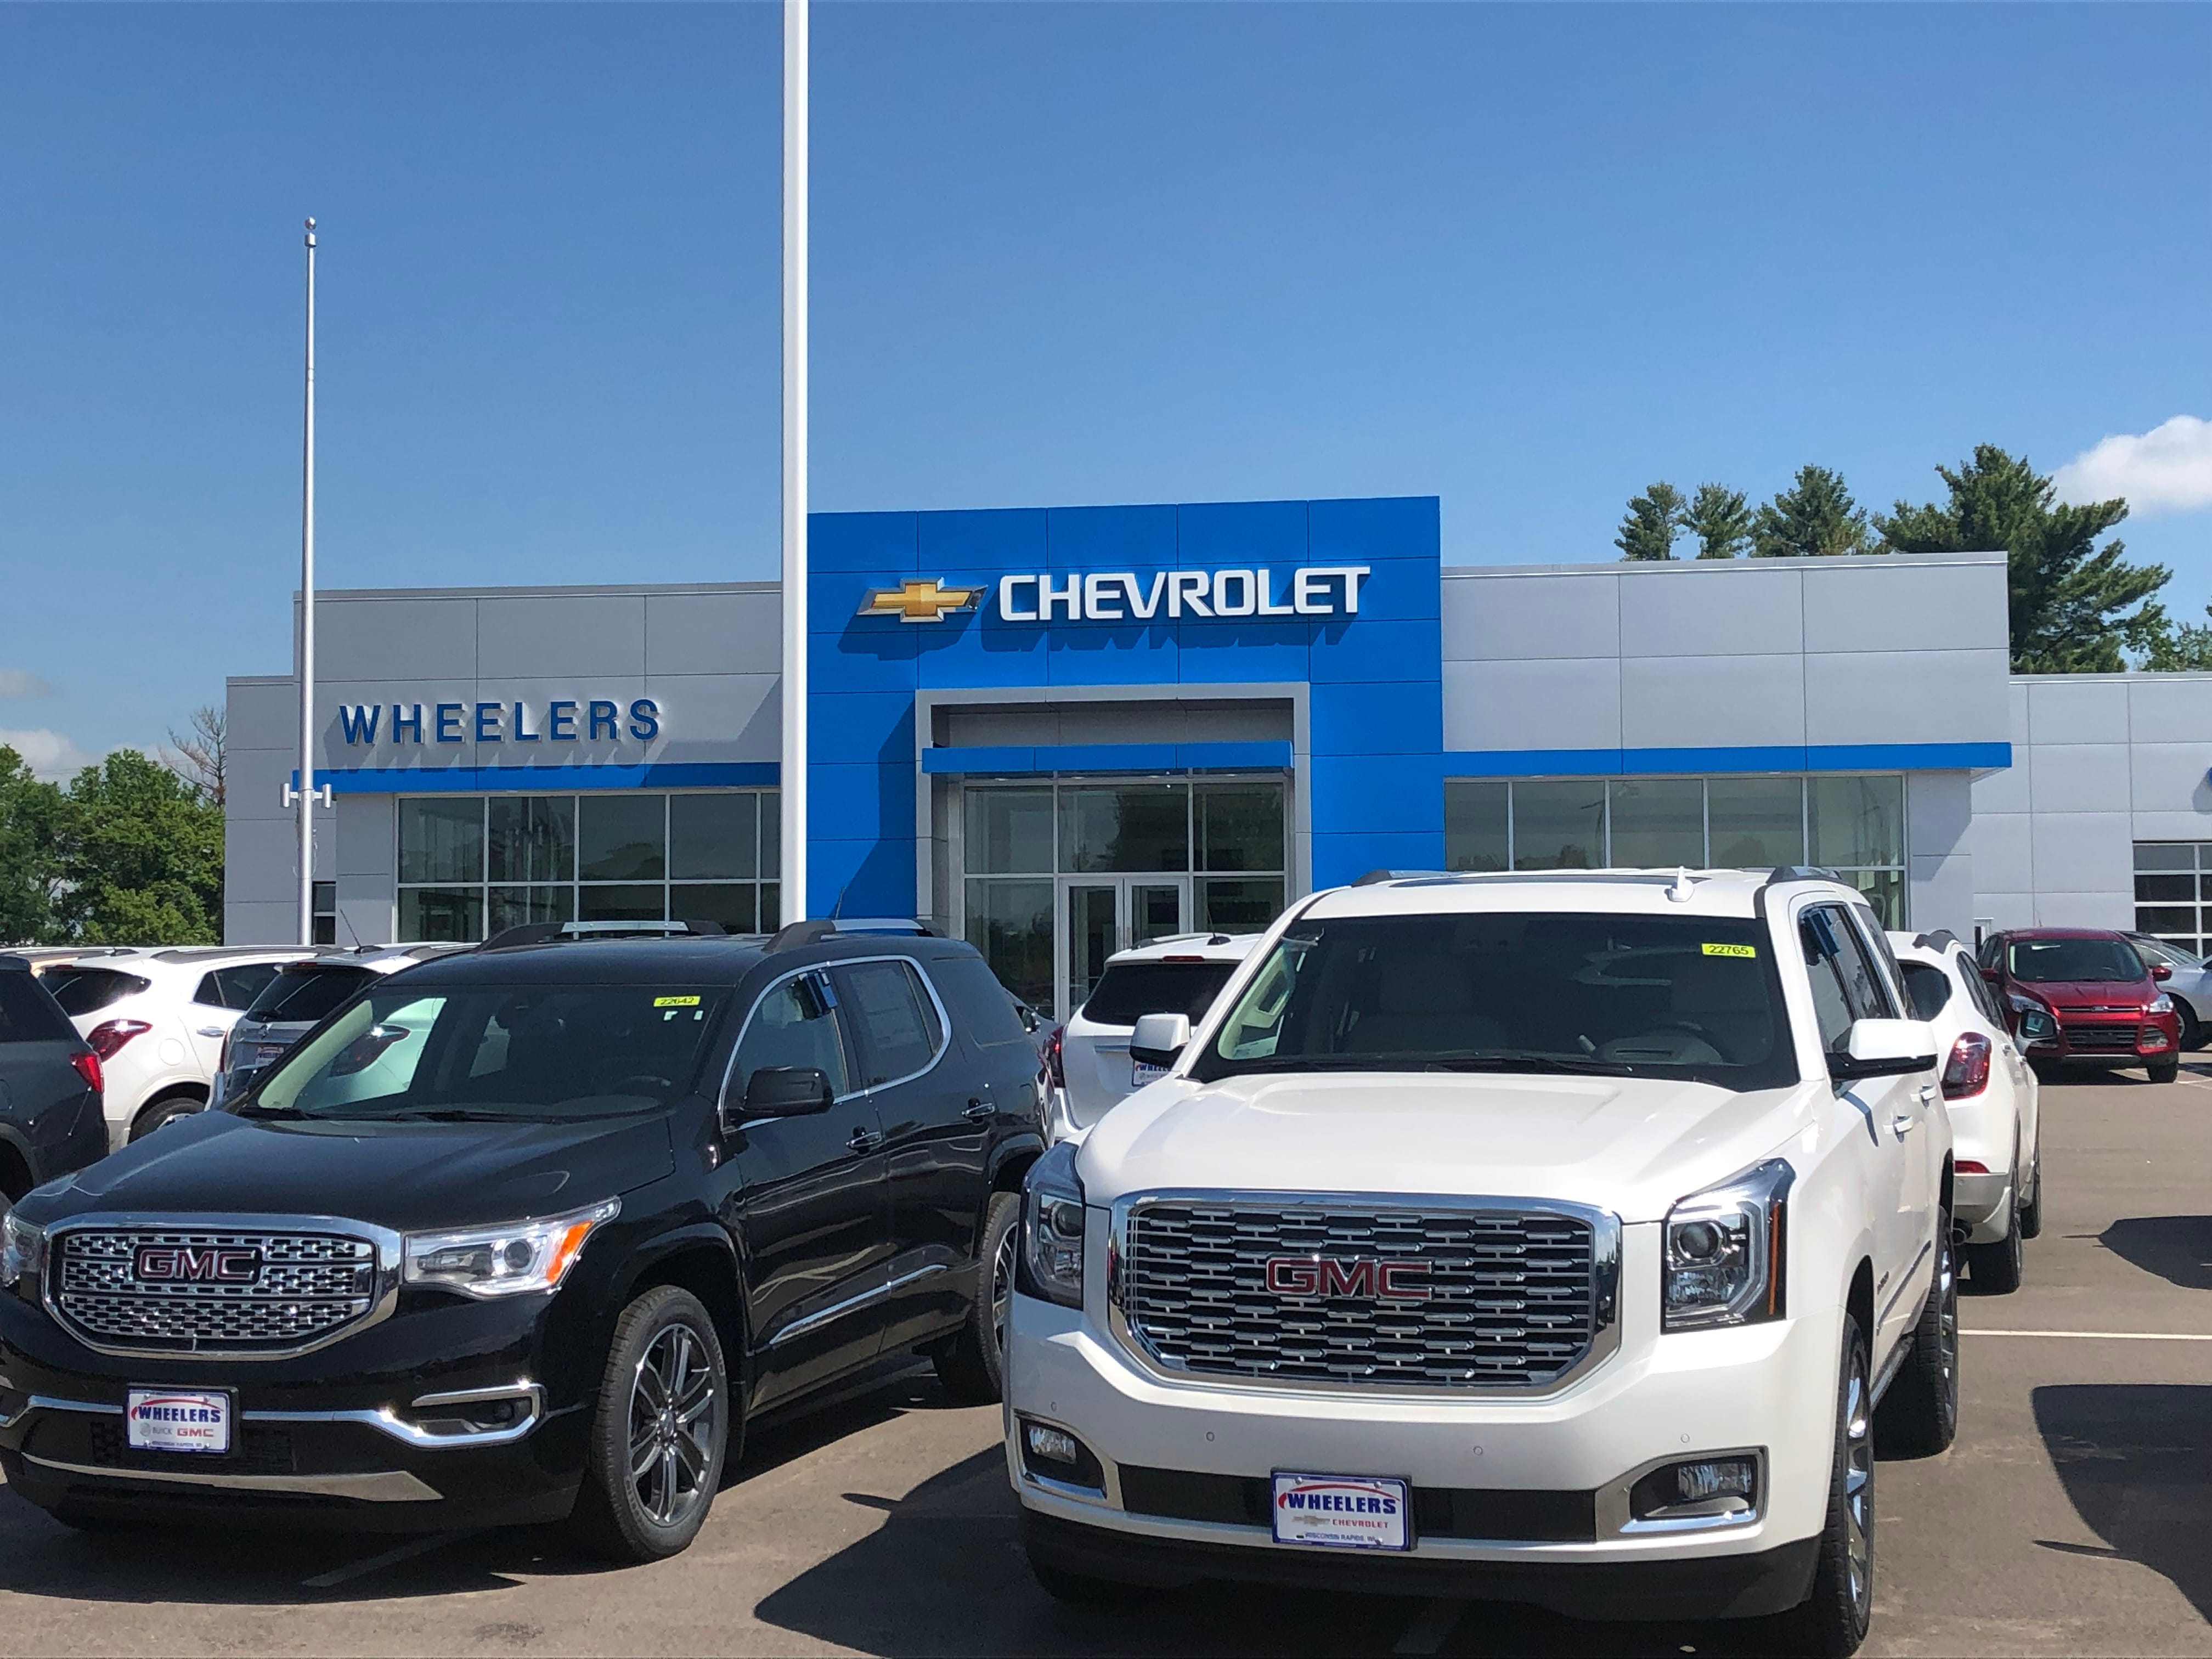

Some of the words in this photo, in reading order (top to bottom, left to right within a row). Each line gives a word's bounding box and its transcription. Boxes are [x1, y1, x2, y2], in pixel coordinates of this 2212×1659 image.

[999, 566, 1370, 620] CHEVROLET
[339, 699, 659, 745] WHEELERS
[1708, 945, 1749, 955] 22765
[138, 1249, 256, 1280] GMC
[1266, 1256, 1432, 1300] GMC
[138, 1406, 221, 1423] WHEELERS
[177, 1428, 214, 1437] GMC
[1287, 1493, 1397, 1515] WHEELERS
[1332, 1518, 1389, 1528] CHEVROLET
